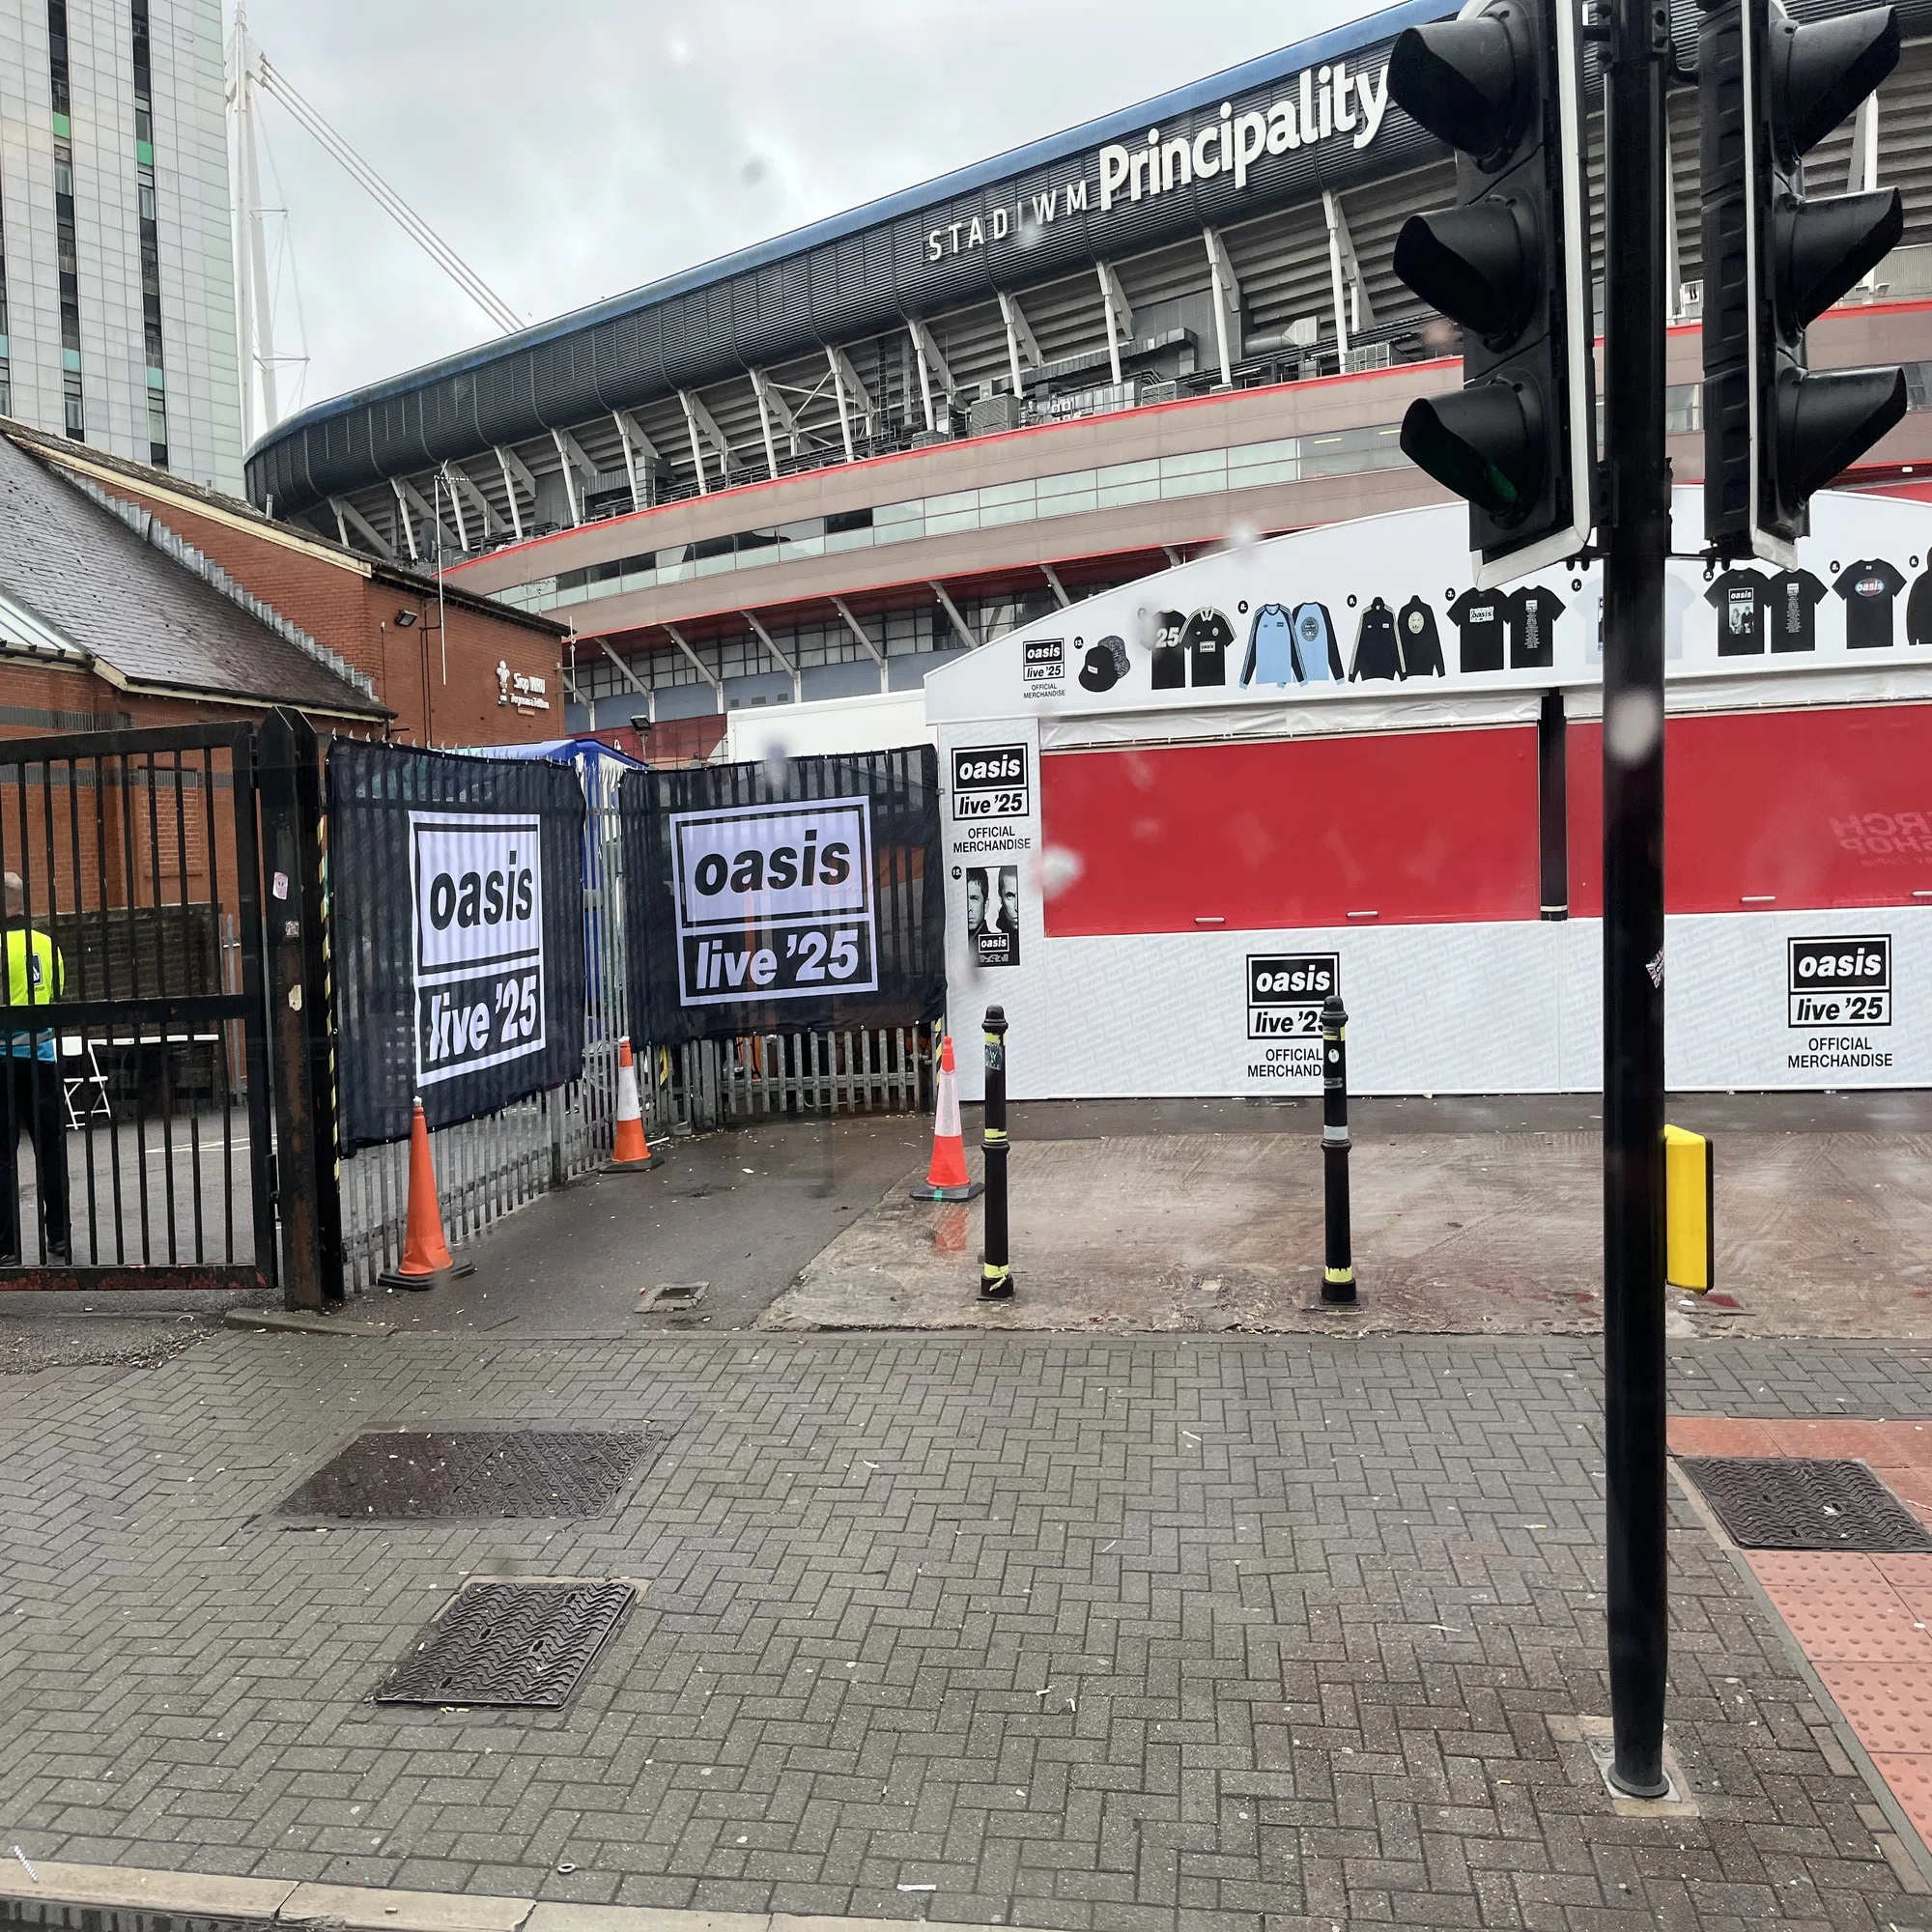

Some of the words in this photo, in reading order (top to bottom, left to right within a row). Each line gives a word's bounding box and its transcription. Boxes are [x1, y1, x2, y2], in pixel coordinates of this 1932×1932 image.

[929, 180, 1088, 261] STADIWM
[1099, 64, 1389, 211] Principality
[1730, 590, 1752, 599] oasis
[1154, 627, 1179, 648] 25
[1027, 644, 1061, 660] oasis
[1027, 668, 1044, 678] live
[1046, 666, 1062, 675] '25
[1023, 690, 1065, 698] MERCHANDISE
[959, 754, 1021, 781] oasis
[959, 794, 991, 815] live
[994, 792, 1023, 812] '25
[968, 825, 1015, 839] OFFICIAL
[952, 838, 1032, 854] MERCHANDISE
[693, 828, 851, 897] oasis
[429, 850, 533, 931] oasis
[980, 936, 1008, 948] oasis
[696, 940, 778, 990] live
[785, 929, 859, 982] '25
[1798, 947, 1882, 978] oasis
[1256, 964, 1331, 993] oasis
[429, 991, 490, 1062] live
[495, 975, 537, 1044] '25
[1797, 998, 1840, 1021] live
[1845, 996, 1884, 1020] '25
[1255, 1011, 1294, 1034] live
[1265, 1047, 1323, 1062] OFFICIAL
[1808, 1037, 1873, 1051] OFFICIAL
[1787, 1053, 1893, 1068] MERCHANDISE
